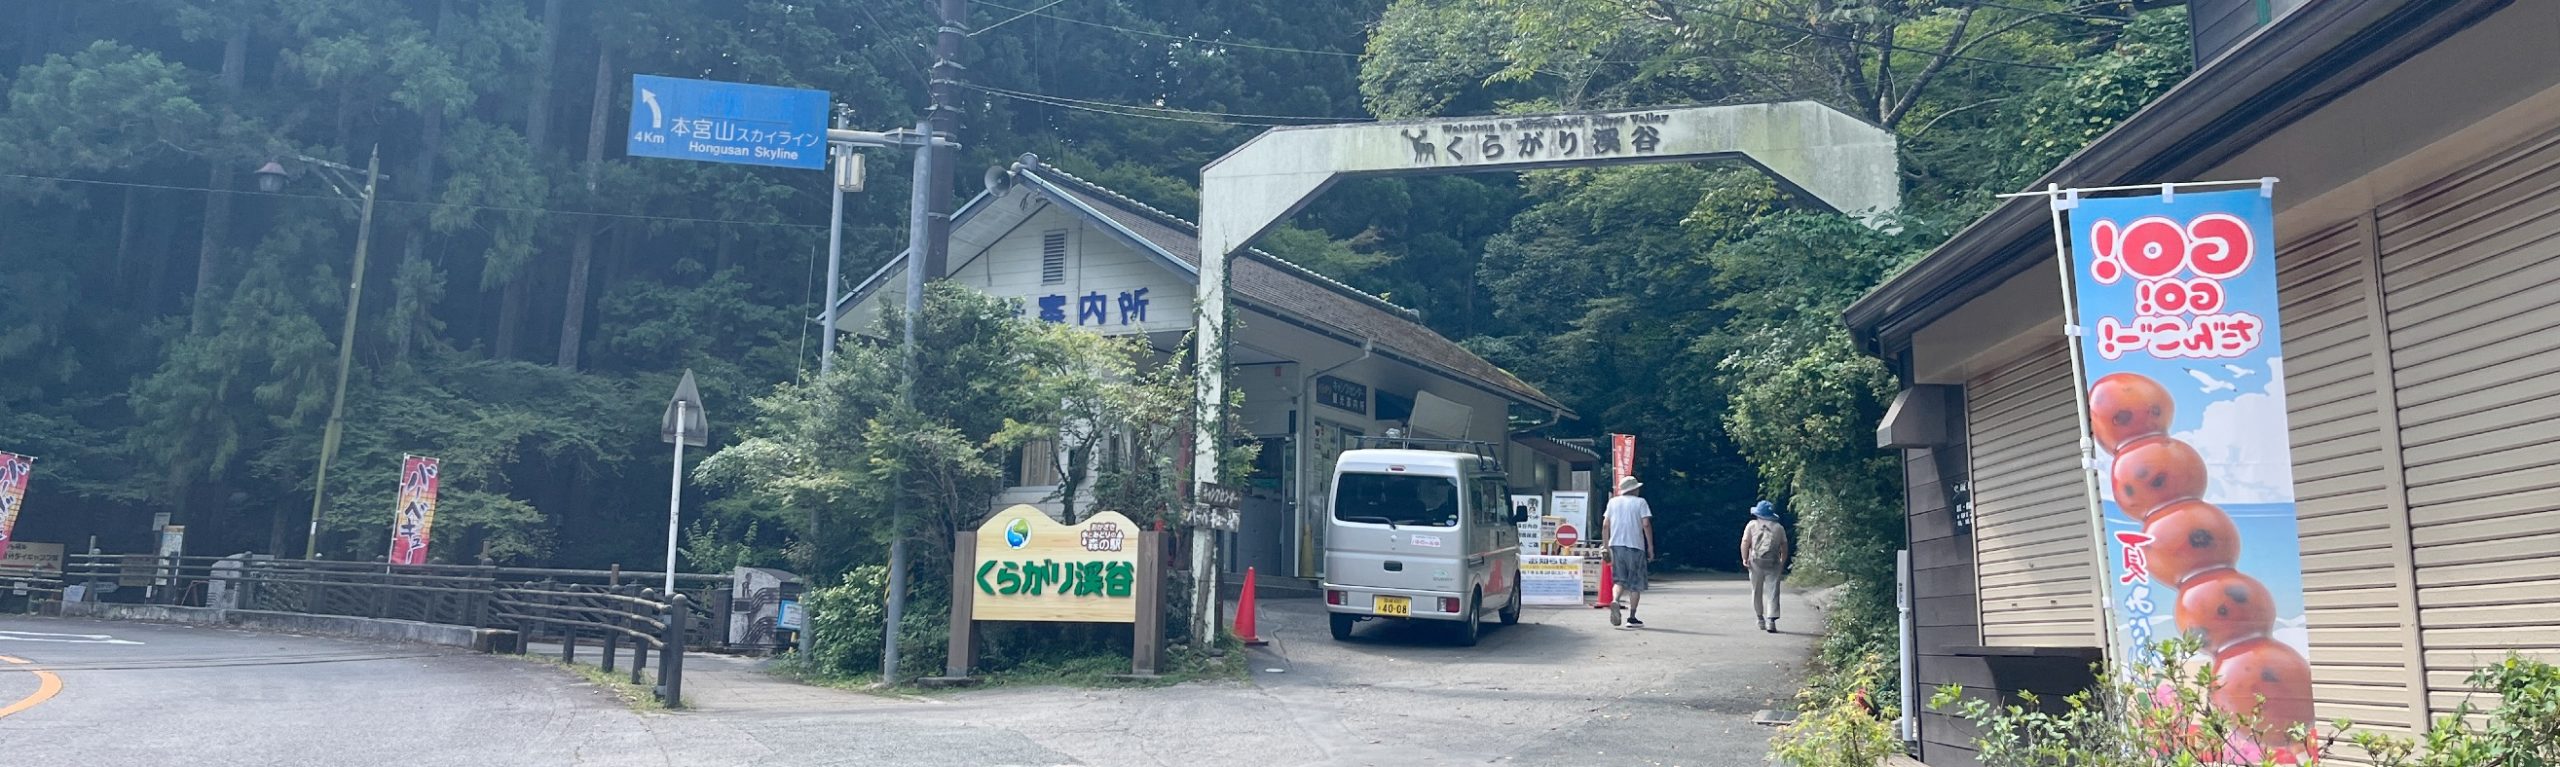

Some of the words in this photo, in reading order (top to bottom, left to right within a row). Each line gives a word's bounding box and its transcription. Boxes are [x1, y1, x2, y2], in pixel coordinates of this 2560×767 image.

[634, 131, 665, 144] 4Km
[670, 117, 819, 147] 本宮山スカイライン
[1442, 124, 1495, 134] Welcome
[1499, 121, 1512, 131] to
[1629, 112, 1669, 125] Valley
[689, 141, 749, 158] Hongusan
[754, 147, 799, 161] Skyline
[1446, 125, 1660, 162] くらがり渓谷
[1010, 287, 1149, 328] 案内所
[400, 463, 437, 564] バーベキュー
[1087, 538, 1121, 550] 森の駅
[976, 559, 1134, 597] くらがり渓谷
